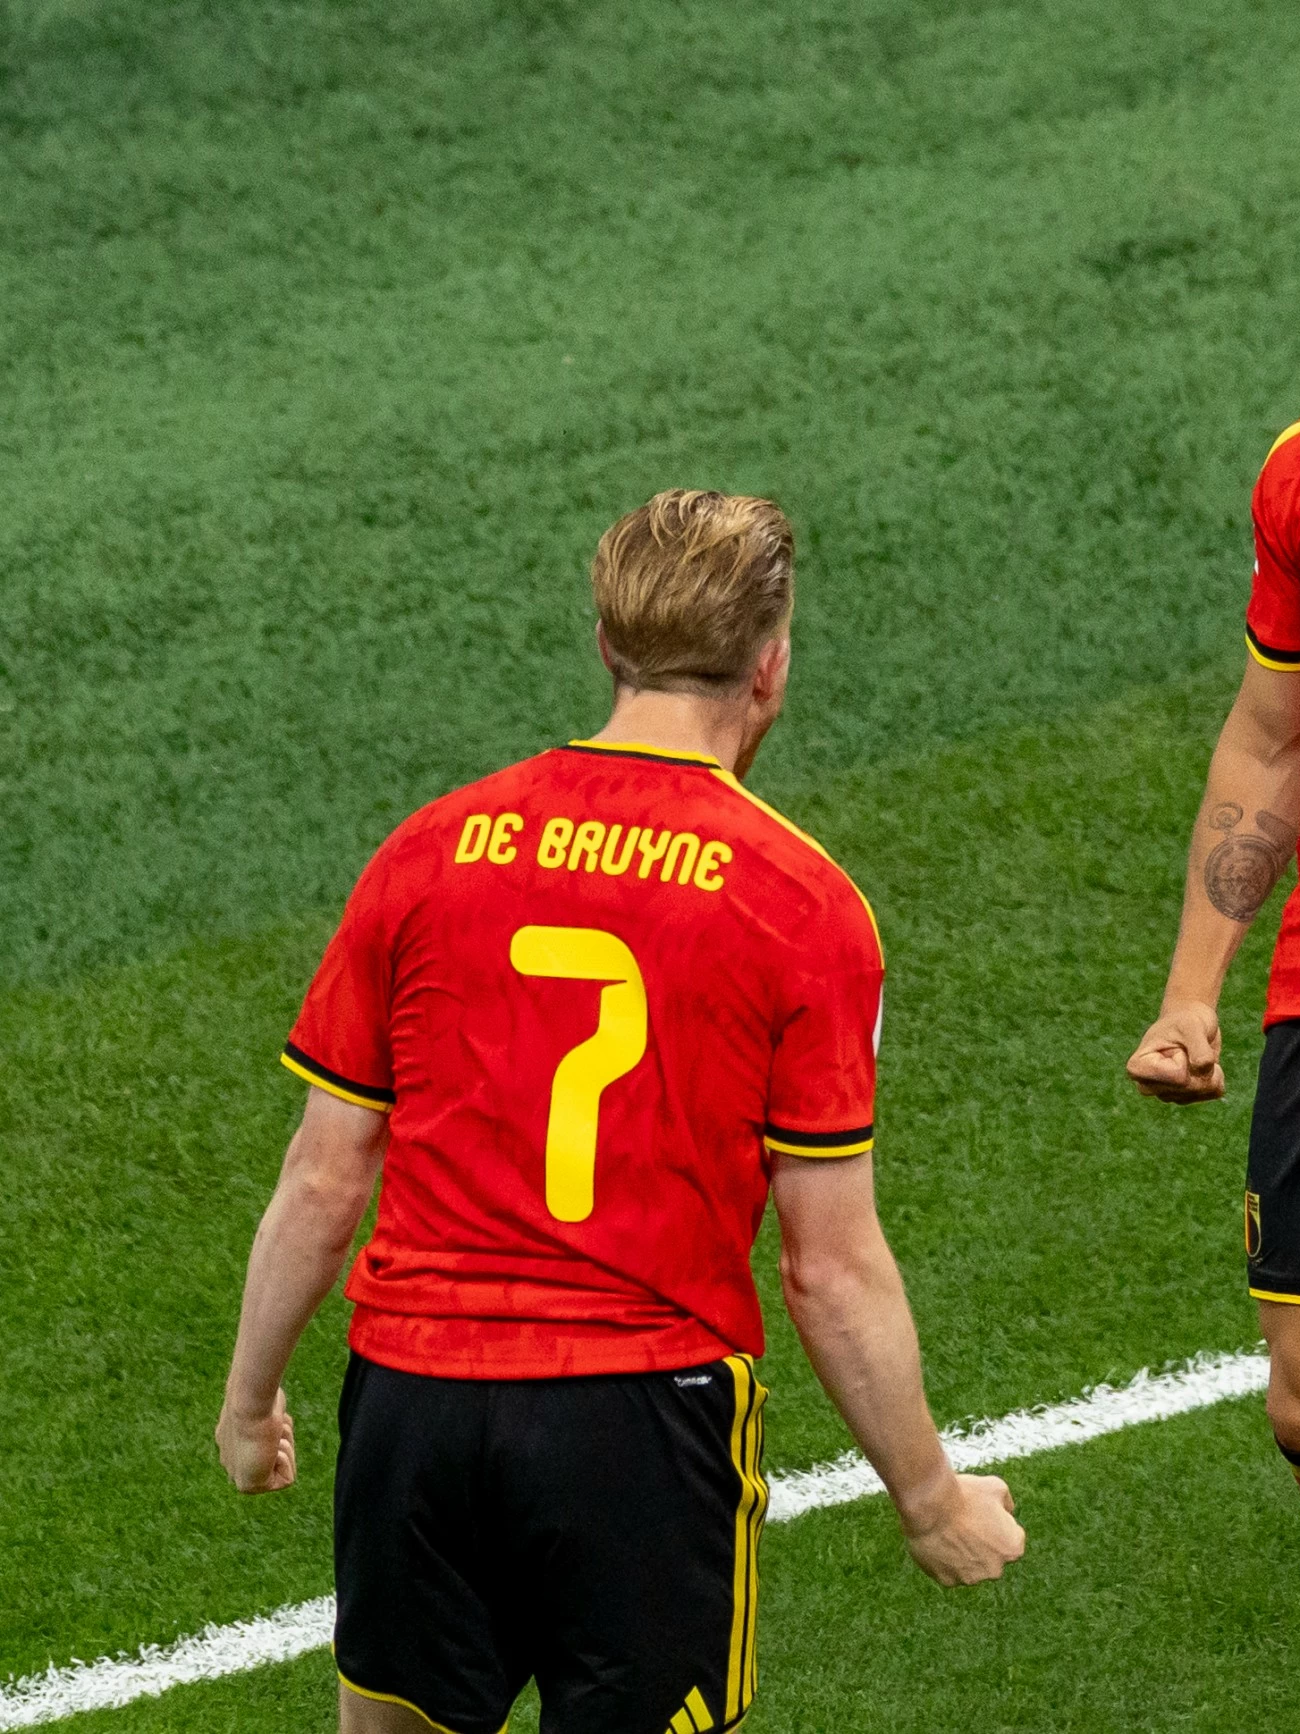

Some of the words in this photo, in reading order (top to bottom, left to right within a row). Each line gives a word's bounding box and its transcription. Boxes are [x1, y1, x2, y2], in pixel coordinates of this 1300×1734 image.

[454, 812, 524, 865] DE
[536, 817, 733, 892] BRUYNE
[509, 925, 648, 1223] 7
